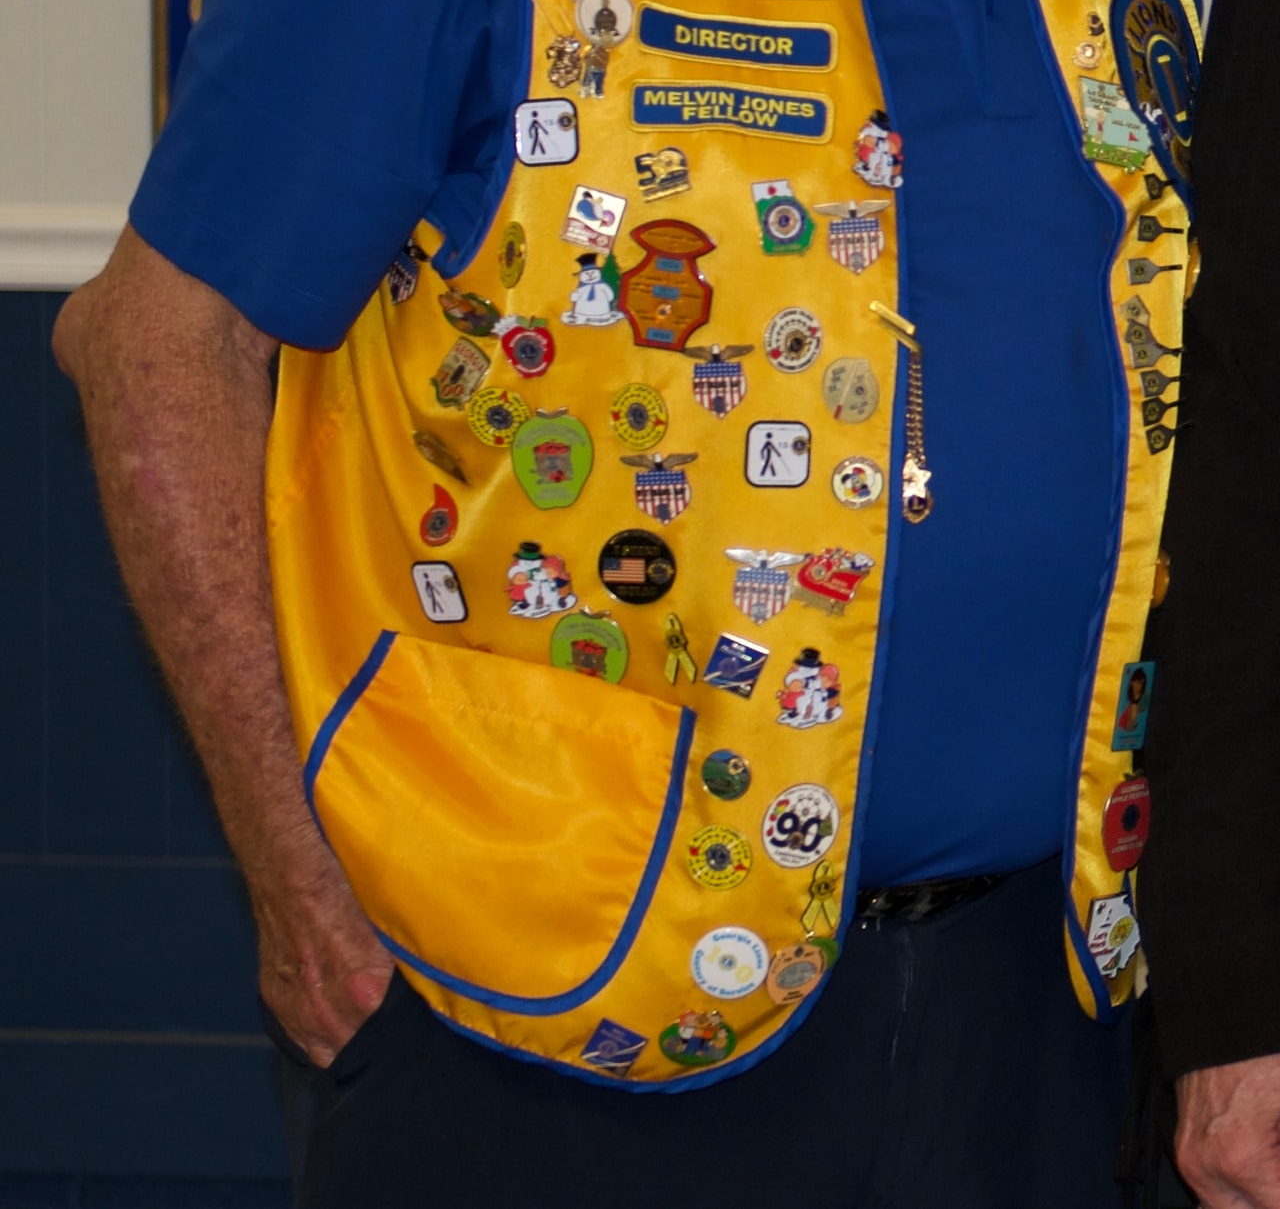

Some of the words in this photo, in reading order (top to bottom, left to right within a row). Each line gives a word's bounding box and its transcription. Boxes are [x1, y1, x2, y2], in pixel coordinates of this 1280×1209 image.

[675, 23, 794, 56] DIRECTOR
[643, 90, 735, 107] MELVIN
[740, 95, 816, 118] JONES
[682, 105, 779, 128] FELLOW
[712, 933, 752, 946] Georgia
[751, 943, 763, 969] Lions
